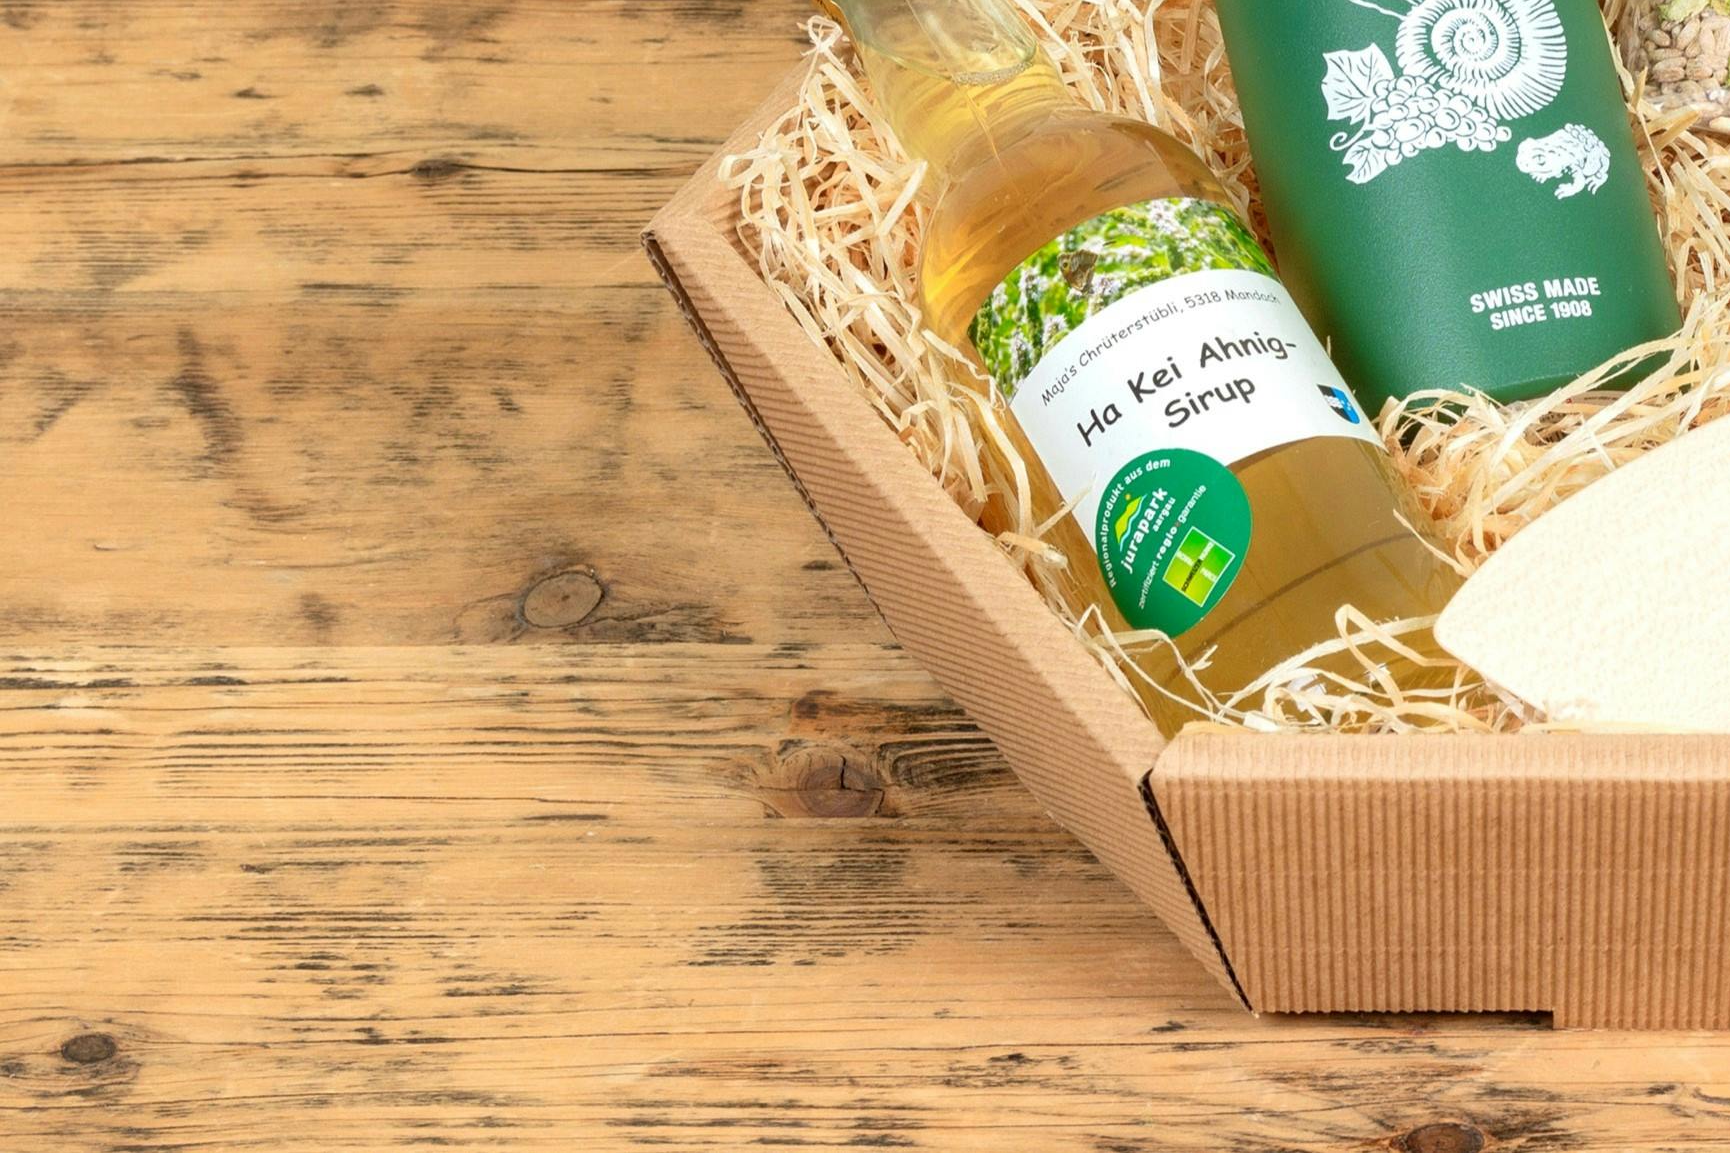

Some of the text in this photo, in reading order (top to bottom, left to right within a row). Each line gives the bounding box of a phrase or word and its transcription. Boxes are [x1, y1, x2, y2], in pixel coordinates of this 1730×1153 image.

[1470, 277, 1601, 313] SWISS MADE
[1490, 300, 1592, 330] SINCE 1908
[1041, 367, 1078, 407] Maja's
[1078, 302, 1185, 368] Chrüterstübli,
[1183, 291, 1222, 309] 5318
[1076, 330, 1297, 448] Ha Kei Ahnig-
[1163, 376, 1256, 428] Sirup
[1100, 458, 1171, 588] Regionalprodukt aus dem
[1121, 487, 1168, 574] jurapark
[1152, 497, 1176, 533] aargau
